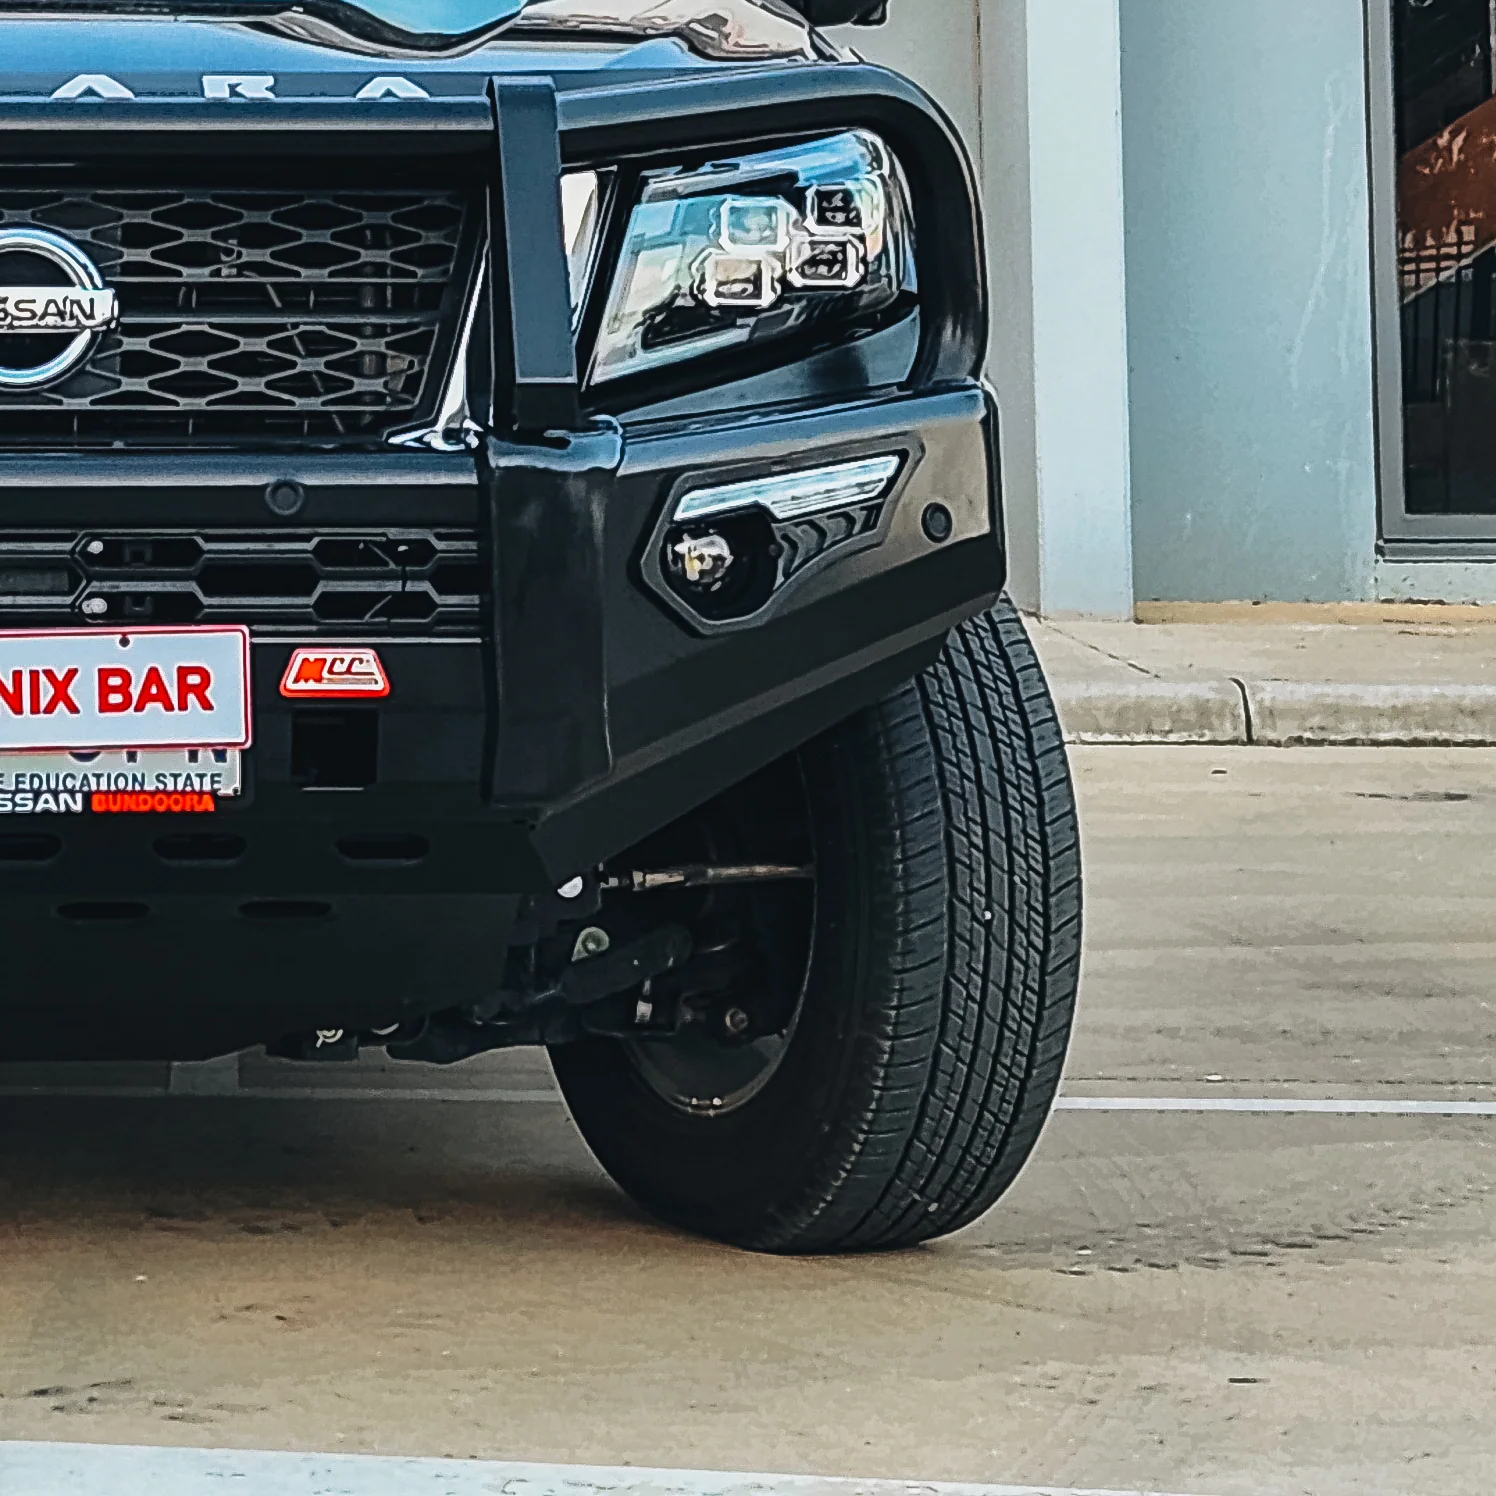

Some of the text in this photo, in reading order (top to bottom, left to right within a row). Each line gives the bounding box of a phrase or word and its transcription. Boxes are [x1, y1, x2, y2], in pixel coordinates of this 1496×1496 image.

[97, 665, 215, 714] BAR
[14, 771, 146, 792] EDUCATION
[155, 772, 223, 792] STATE
